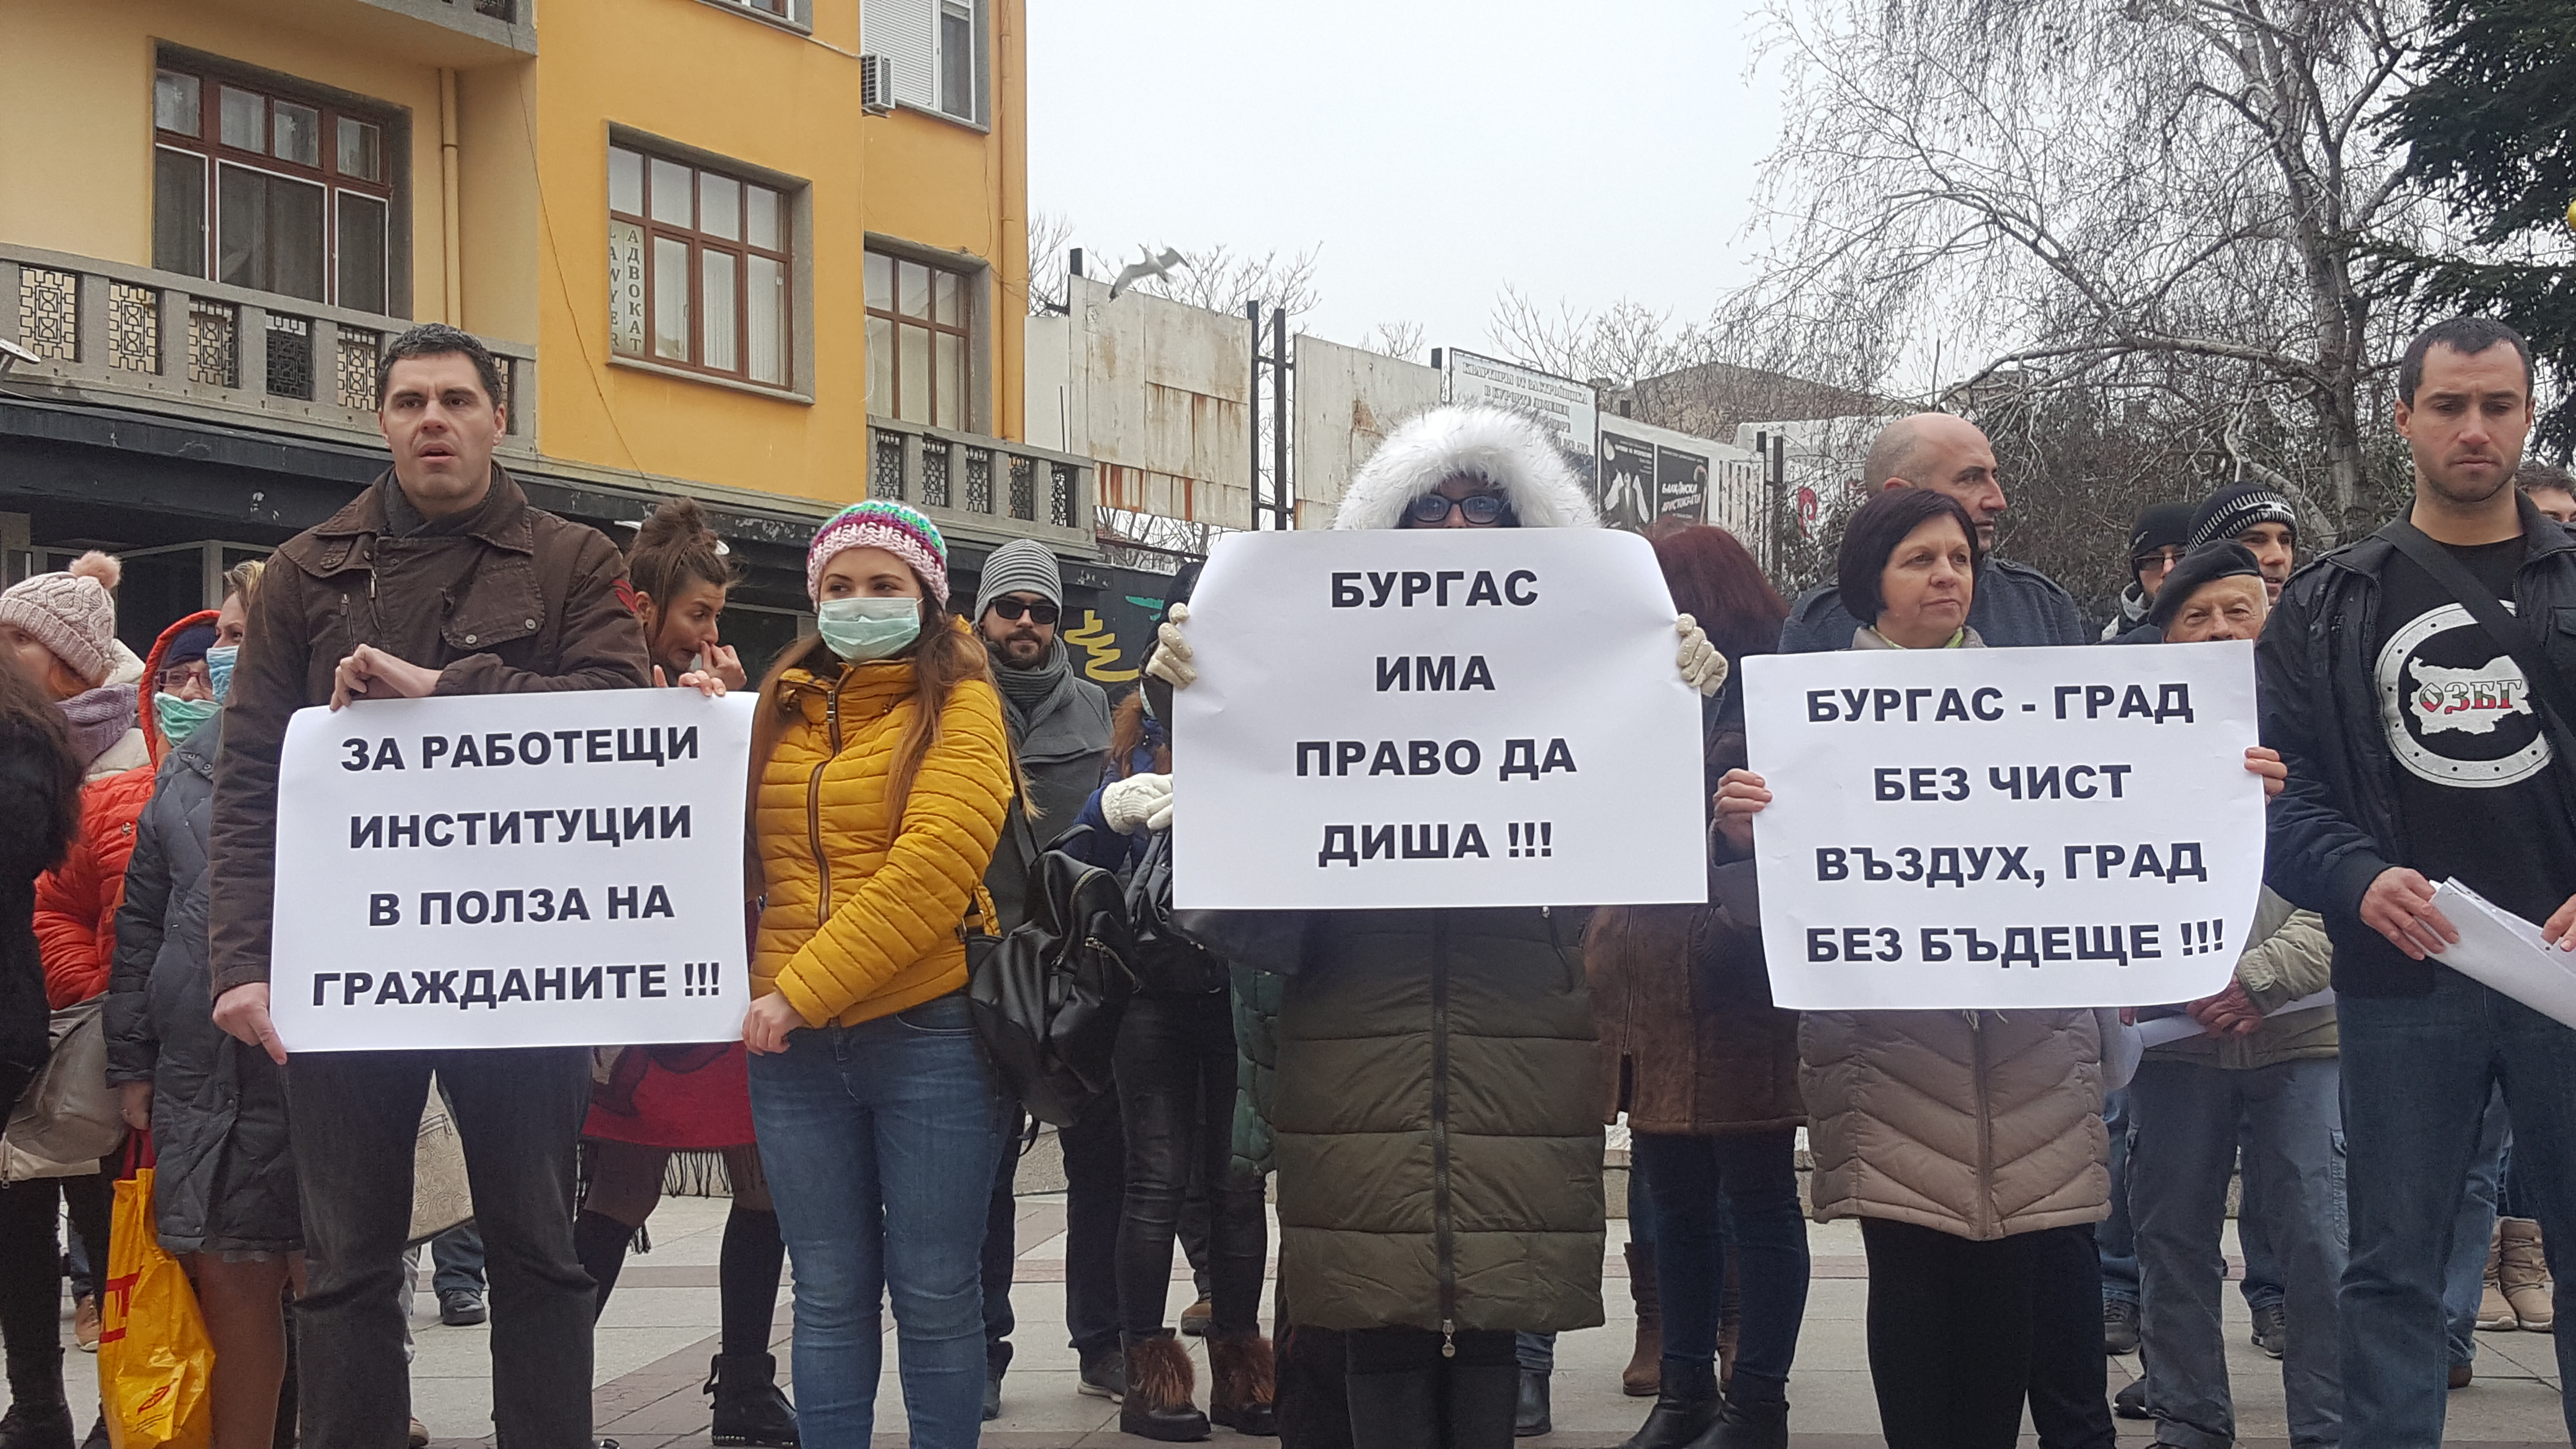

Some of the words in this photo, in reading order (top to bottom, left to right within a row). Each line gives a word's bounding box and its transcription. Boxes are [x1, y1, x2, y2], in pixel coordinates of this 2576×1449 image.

[627, 229, 642, 352] АДВОКАТ
[1332, 570, 1538, 608] БУРГАС
[1376, 655, 1496, 692] ИМА
[1806, 687, 2004, 722] БУРГАС
[2021, 704, 2036, 712] -
[2054, 683, 2194, 724] ГРАД
[2419, 679, 2523, 715] ОЗБГ
[341, 738, 405, 771] ЗА
[422, 726, 698, 769] РАБОТЕЩИ
[1296, 740, 1481, 776] ПРАВО
[1499, 738, 1577, 782] ДА
[1874, 767, 1970, 801] БЕЗ
[1989, 764, 2132, 800] ЧИСТ
[350, 805, 691, 849] ИНСТИТУЦИИ
[1319, 823, 1490, 868] ДИША
[1508, 822, 1551, 857] !!!
[1816, 846, 2045, 888] ВЪЗДУХ,
[2064, 842, 2207, 884] ГРАД
[370, 893, 400, 926] В
[420, 888, 591, 925] ПОЛЗА
[608, 885, 675, 919] НА
[1806, 927, 1902, 962] БЕЗ
[1920, 924, 2161, 968] БЪДЕЩЕ
[2180, 918, 2223, 956] !!!
[313, 964, 667, 1010] ГРАЖДАНИТЕ
[685, 962, 719, 997] !!!
